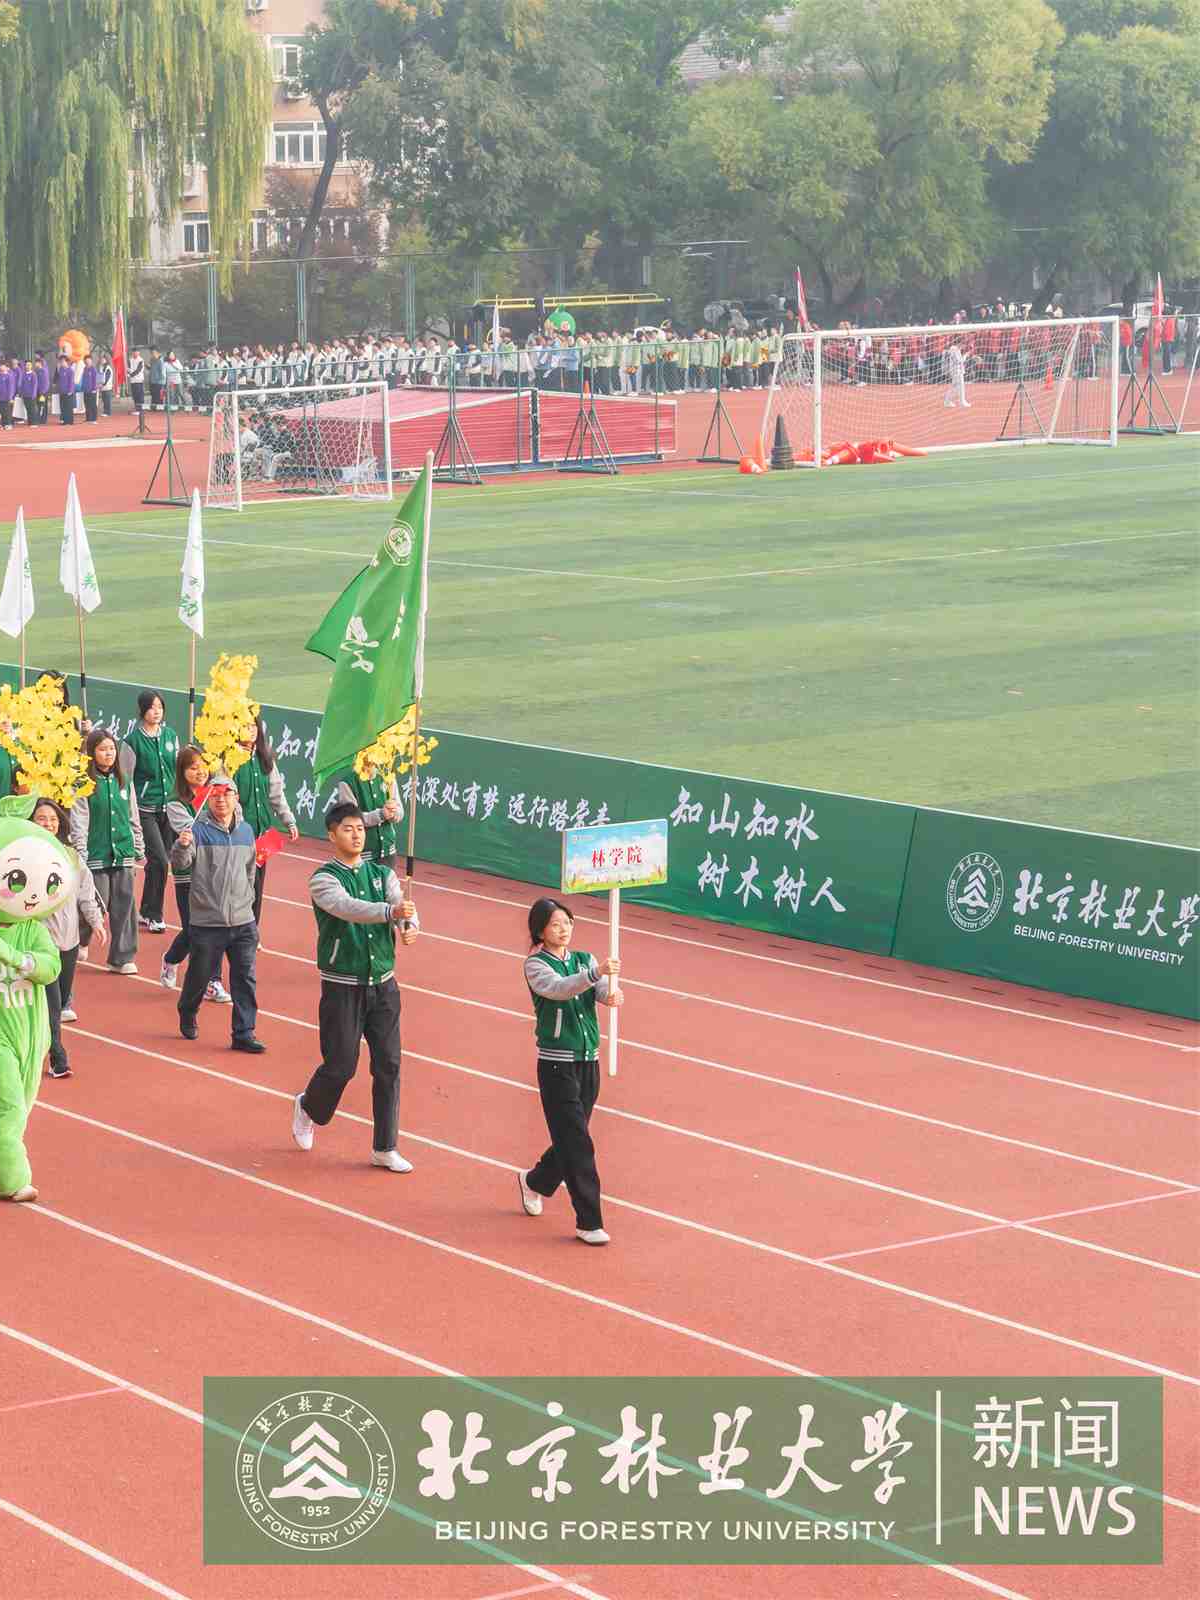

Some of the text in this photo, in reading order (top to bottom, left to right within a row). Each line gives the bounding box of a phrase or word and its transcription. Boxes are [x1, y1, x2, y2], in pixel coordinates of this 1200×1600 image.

[669, 785, 820, 850] 知山知水
[591, 846, 643, 868] 林学院
[697, 851, 847, 913] 树木树人
[1013, 924, 1185, 966] BEIJING FORESTRY UNIVERSITY
